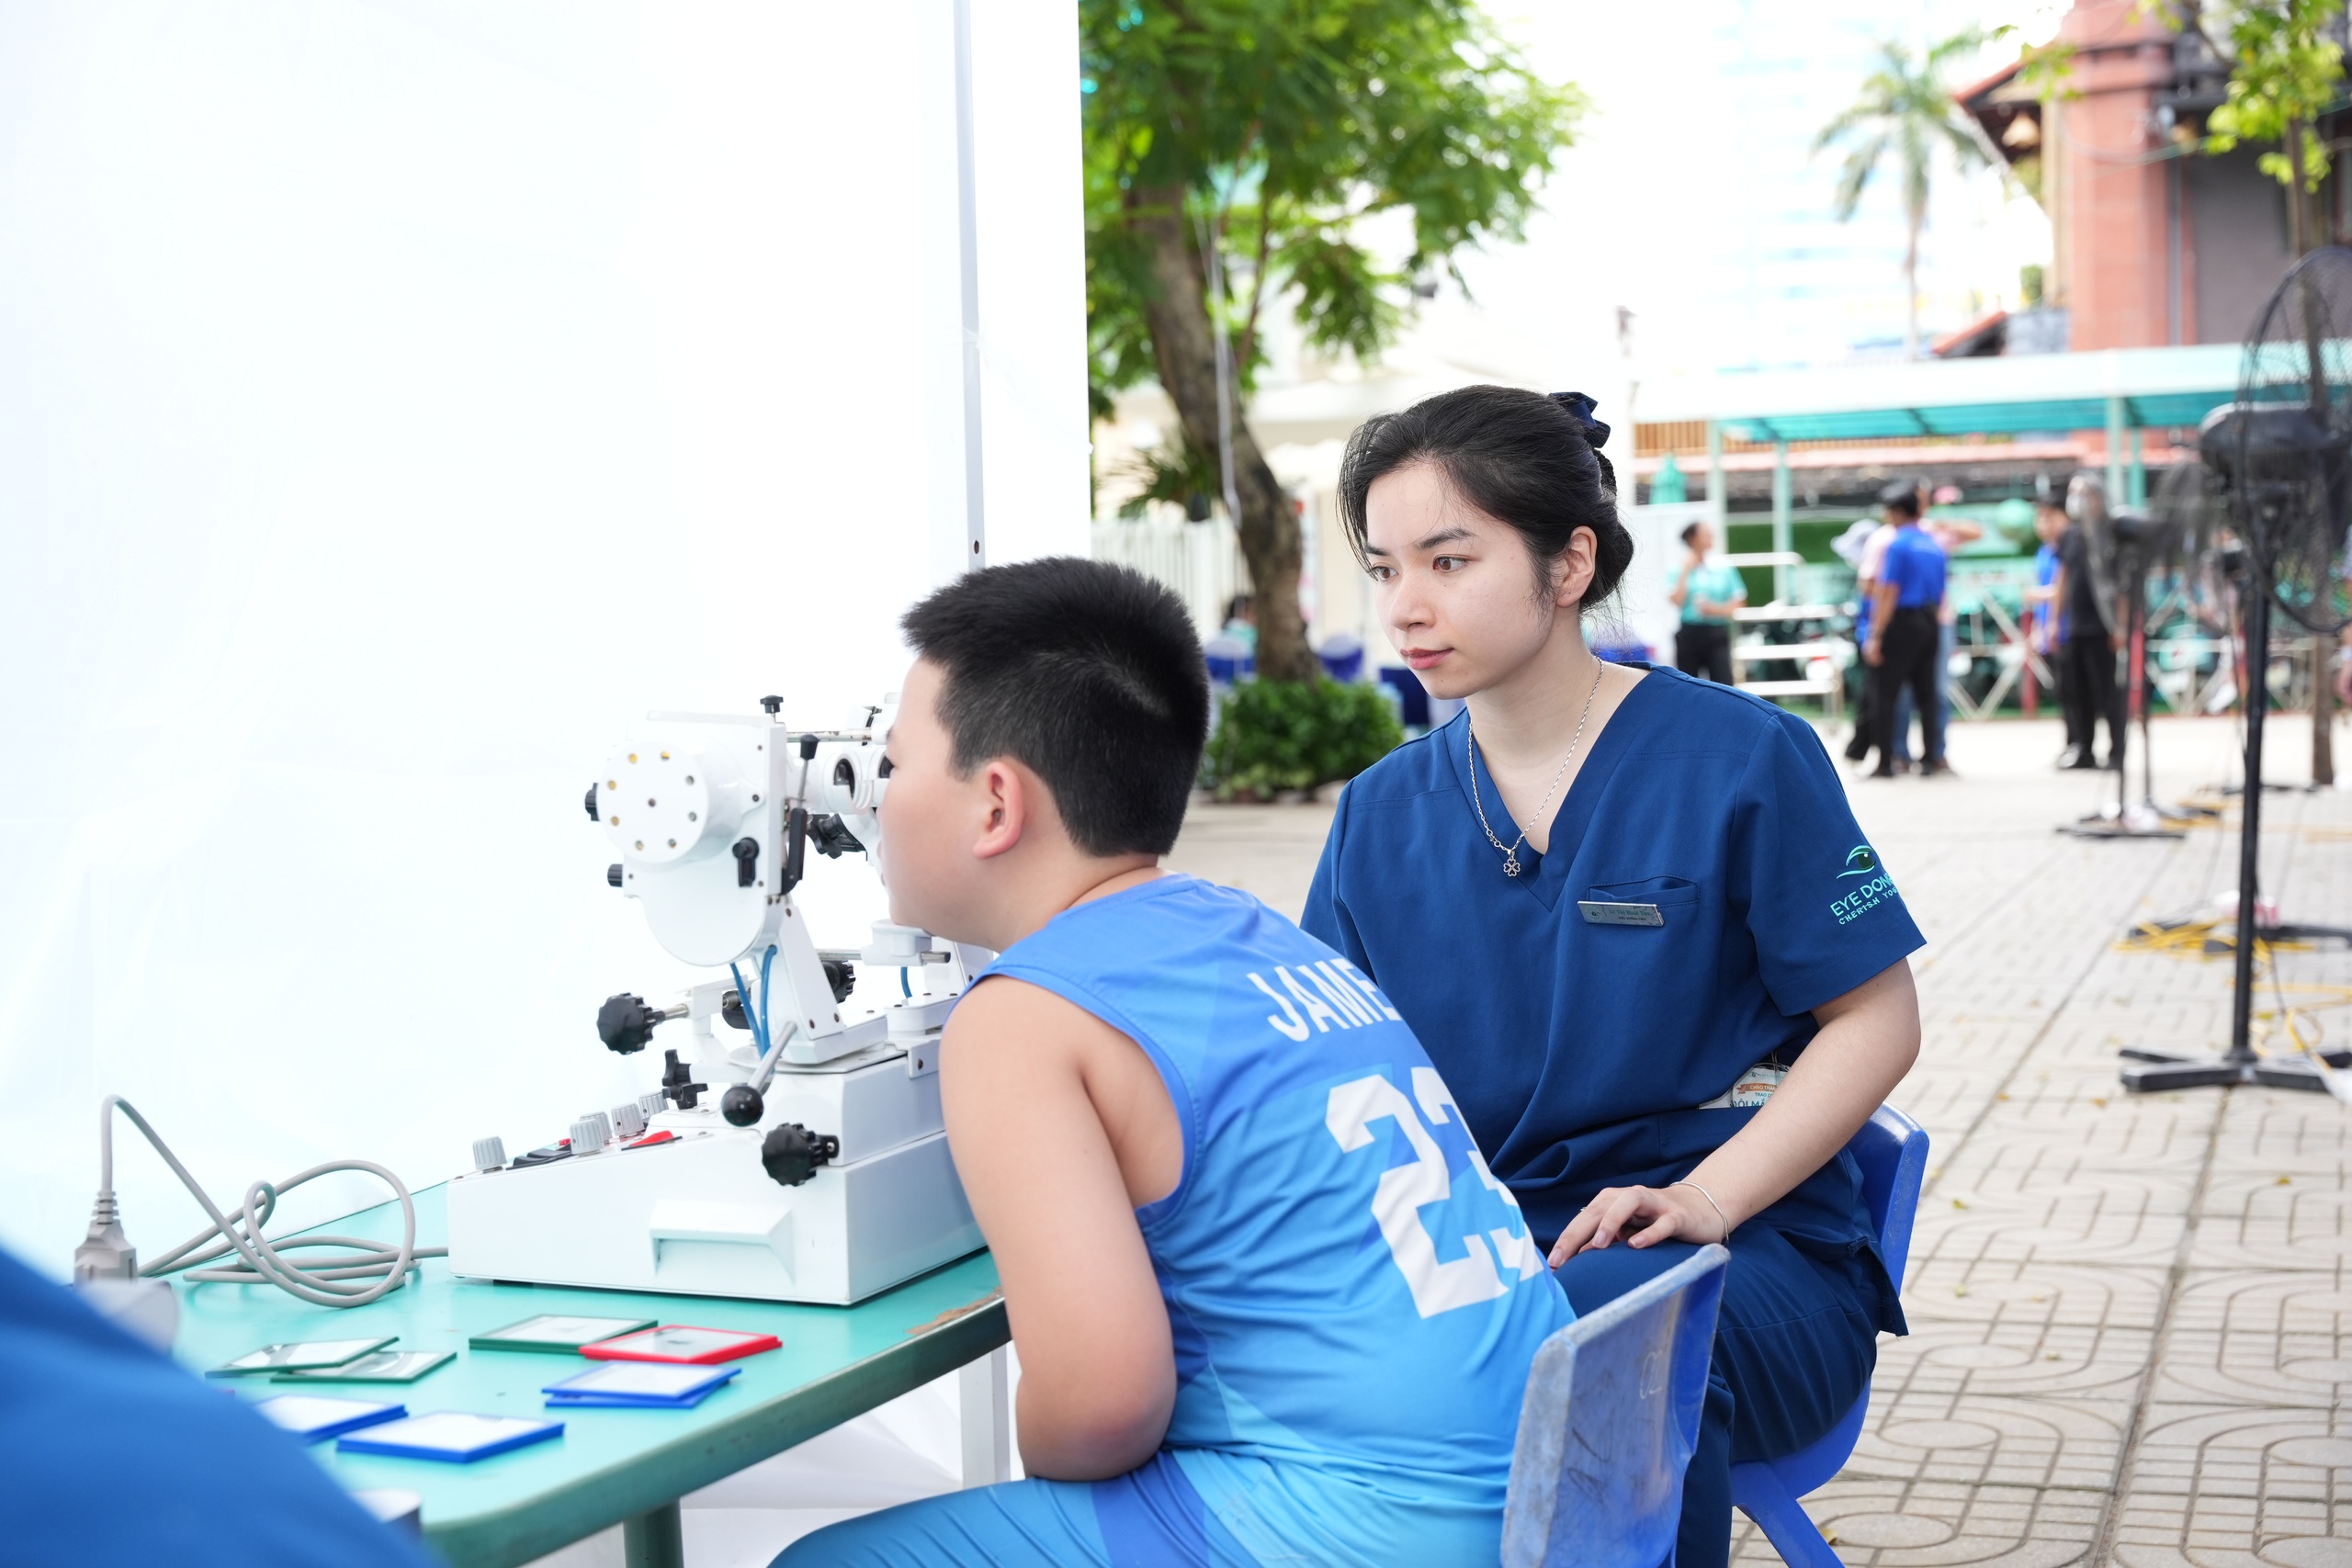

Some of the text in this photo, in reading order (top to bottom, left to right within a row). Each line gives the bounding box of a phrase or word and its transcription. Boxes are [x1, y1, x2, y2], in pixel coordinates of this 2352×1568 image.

[1830, 891, 1862, 917] EYE
[1246, 958, 1402, 1043] JAME
[1751, 1098, 1765, 1106] MẮ
